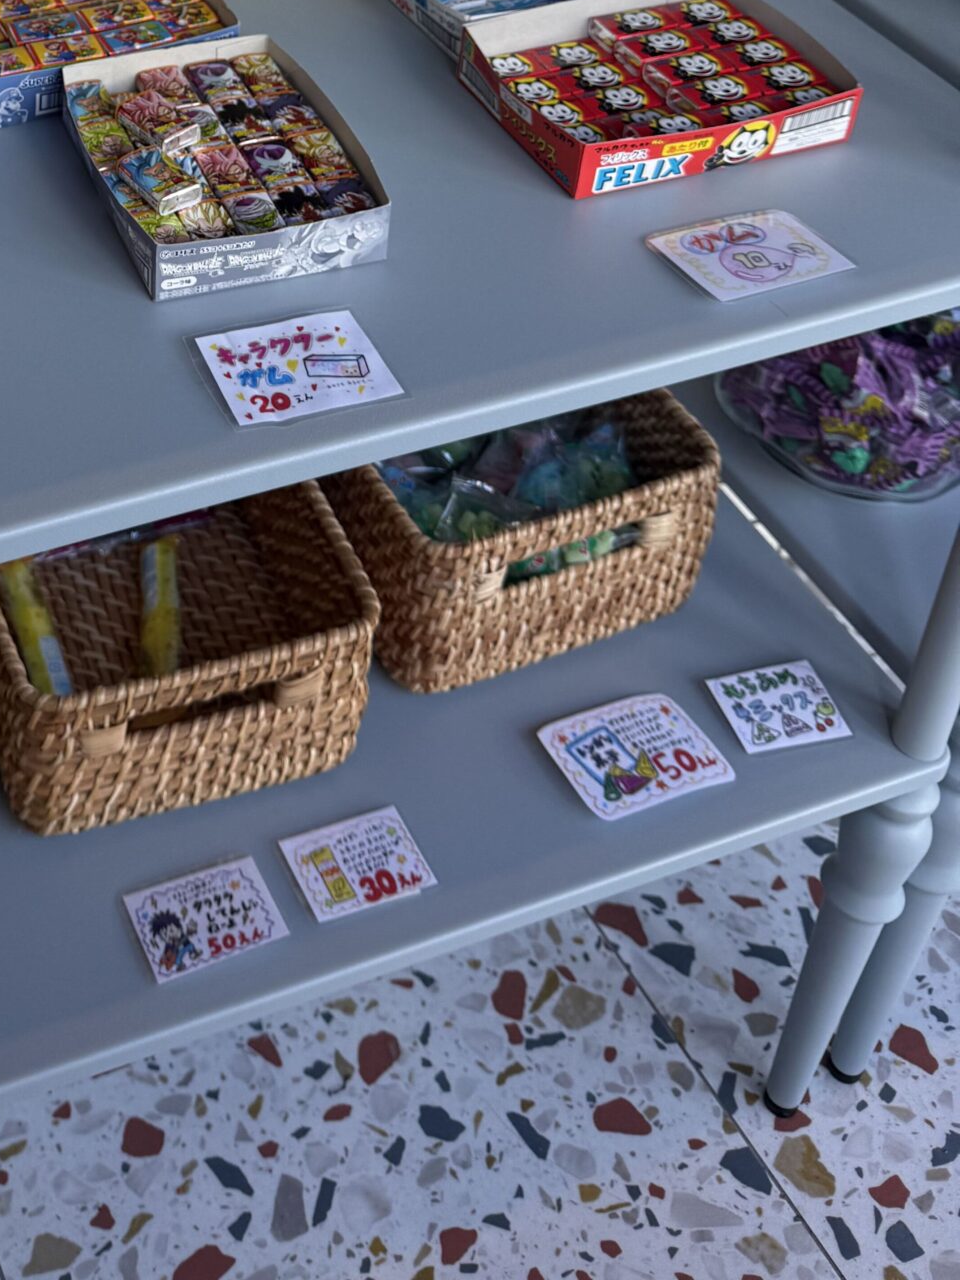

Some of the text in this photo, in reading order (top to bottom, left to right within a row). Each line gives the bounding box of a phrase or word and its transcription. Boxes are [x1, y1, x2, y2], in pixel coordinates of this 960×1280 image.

[600, 149, 649, 166] フィリックス
[594, 153, 691, 192] FELIX
[216, 331, 335, 367] キャラクター
[238, 365, 295, 388] ガム
